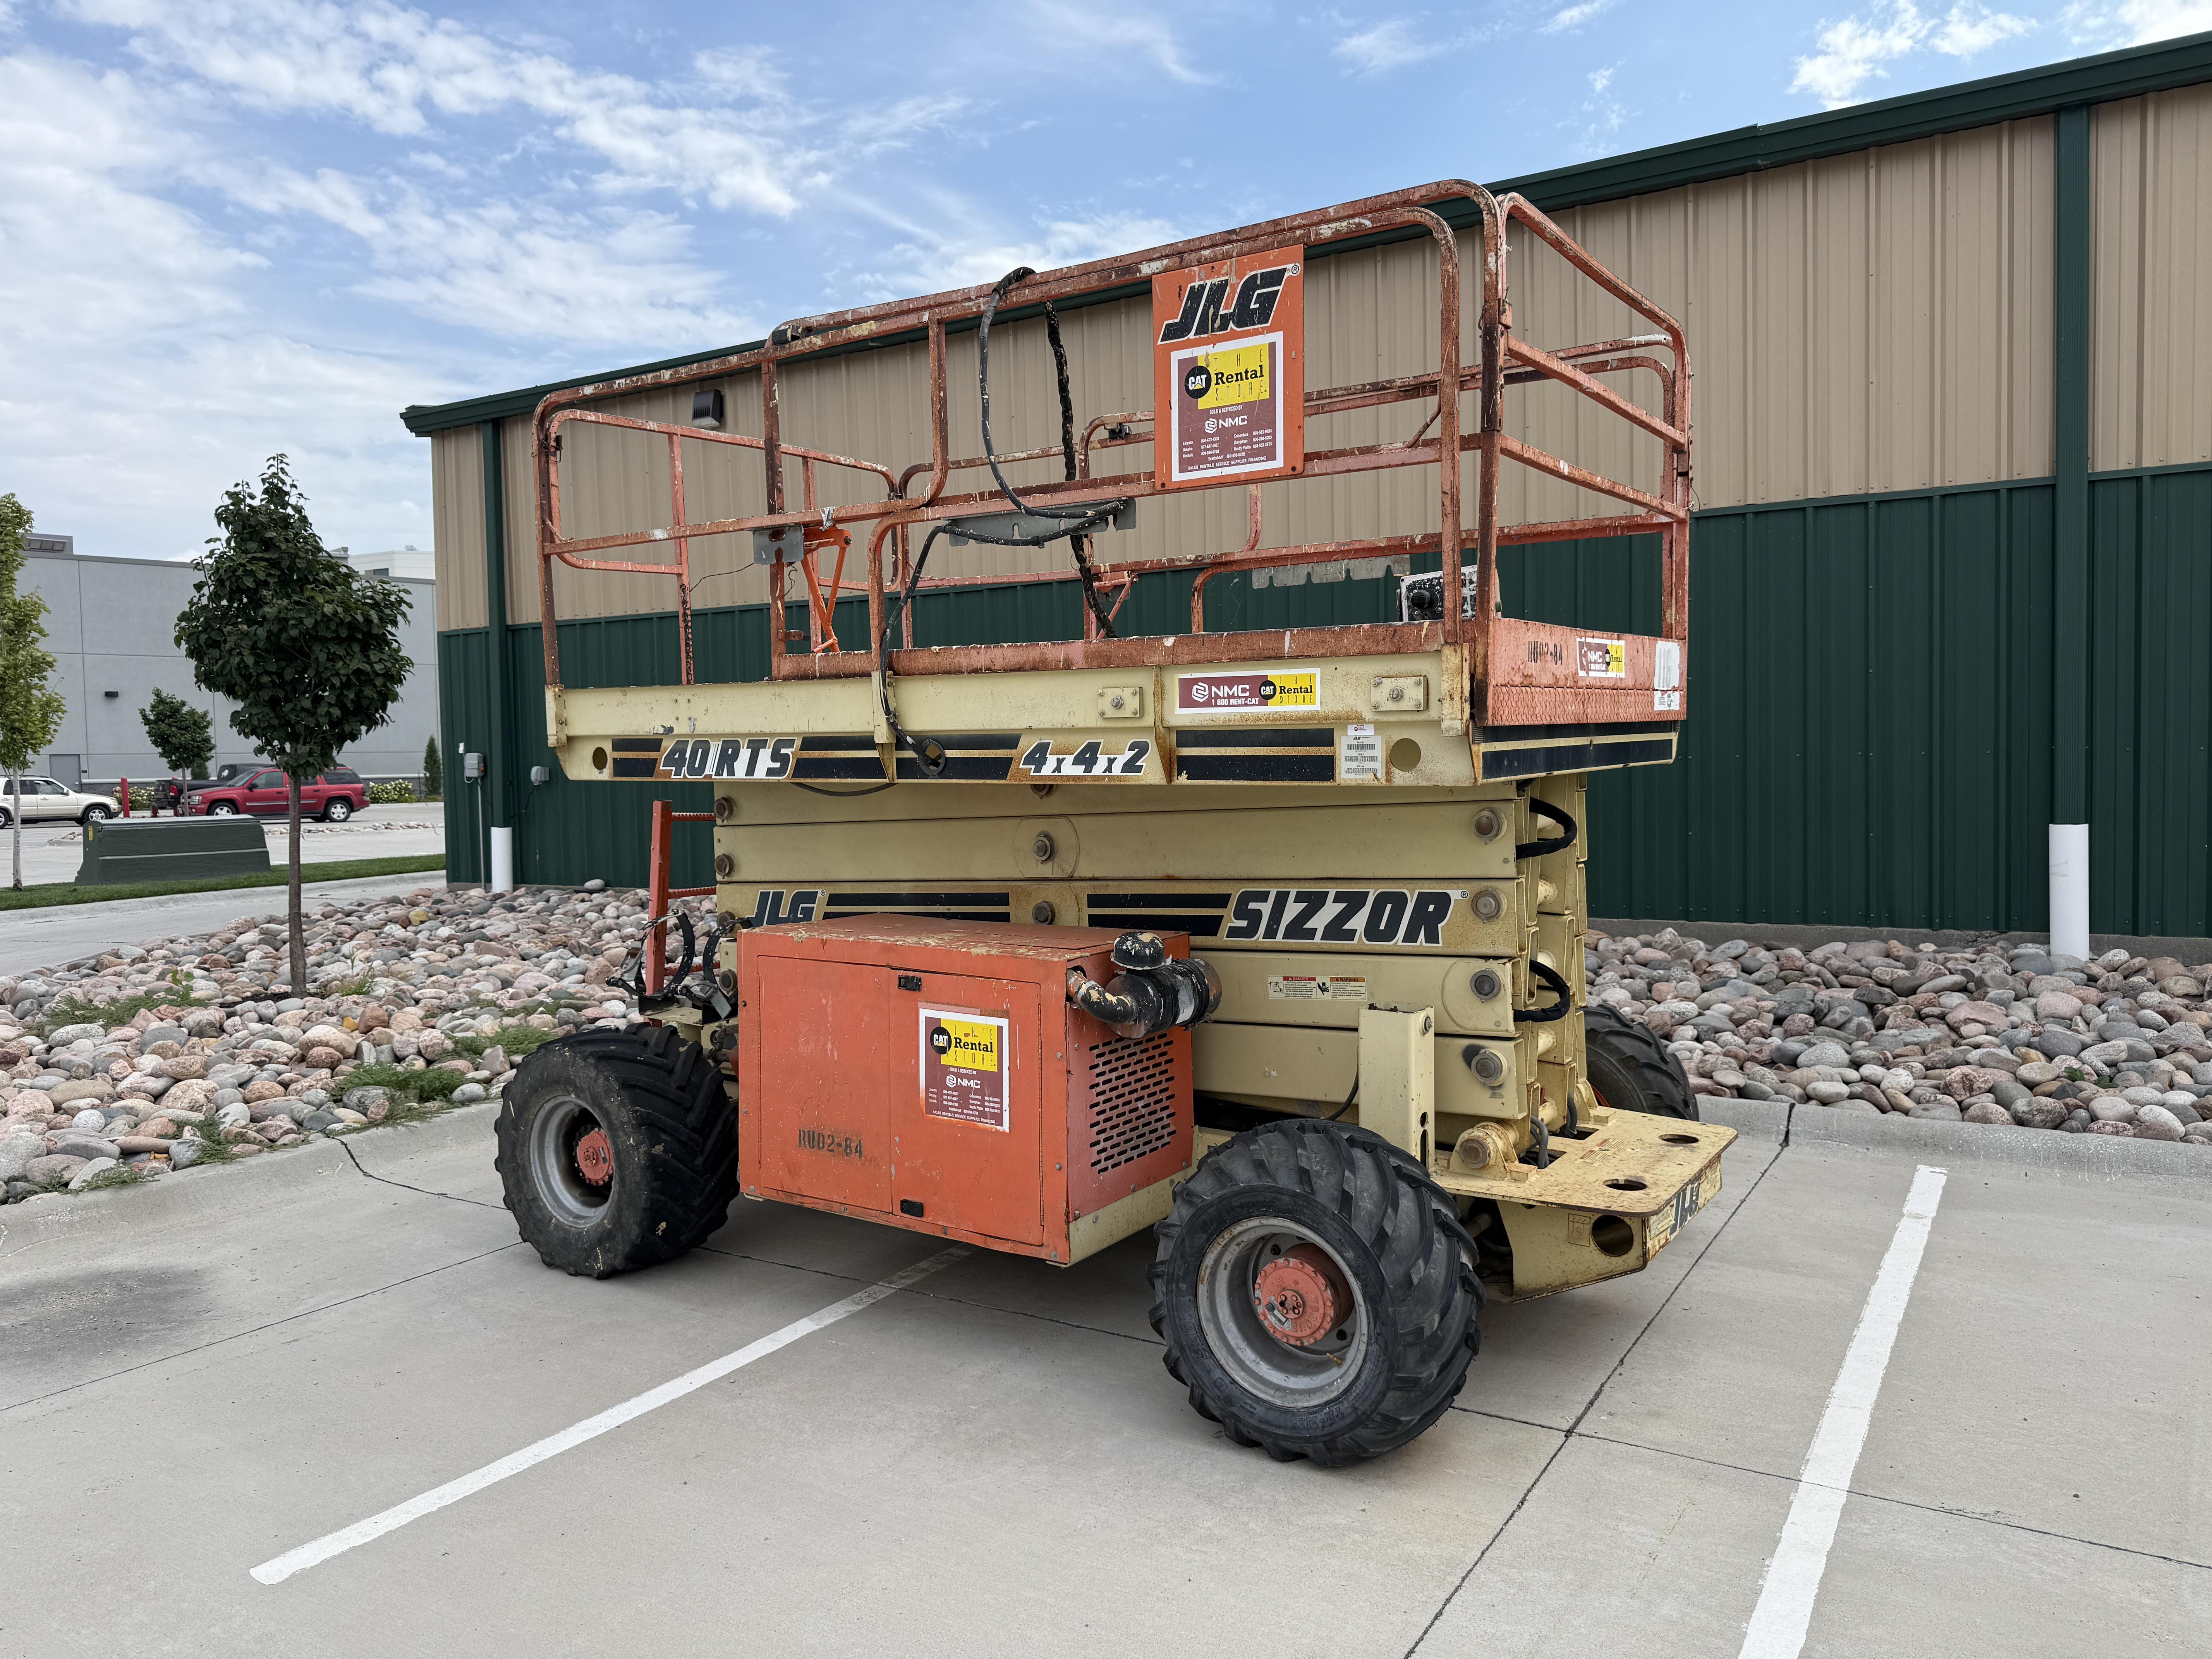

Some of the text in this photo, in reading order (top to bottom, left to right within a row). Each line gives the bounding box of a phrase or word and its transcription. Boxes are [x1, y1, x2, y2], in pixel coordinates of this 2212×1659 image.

[1214, 349, 1263, 371] THE
[1214, 364, 1264, 386] Rental
[1188, 374, 1207, 390] CAT
[1219, 415, 1248, 428] NMC
[1588, 650, 1602, 663] NMC
[1211, 685, 1250, 697] NMC
[1261, 686, 1274, 695] CAT
[1279, 685, 1313, 694] Rental
[954, 1024, 993, 1040] THE
[933, 1034, 947, 1047] CAT
[954, 1037, 994, 1053] Rental
[957, 1077, 981, 1089] NMC
[1292, 1297, 1319, 1333] TORQUE
